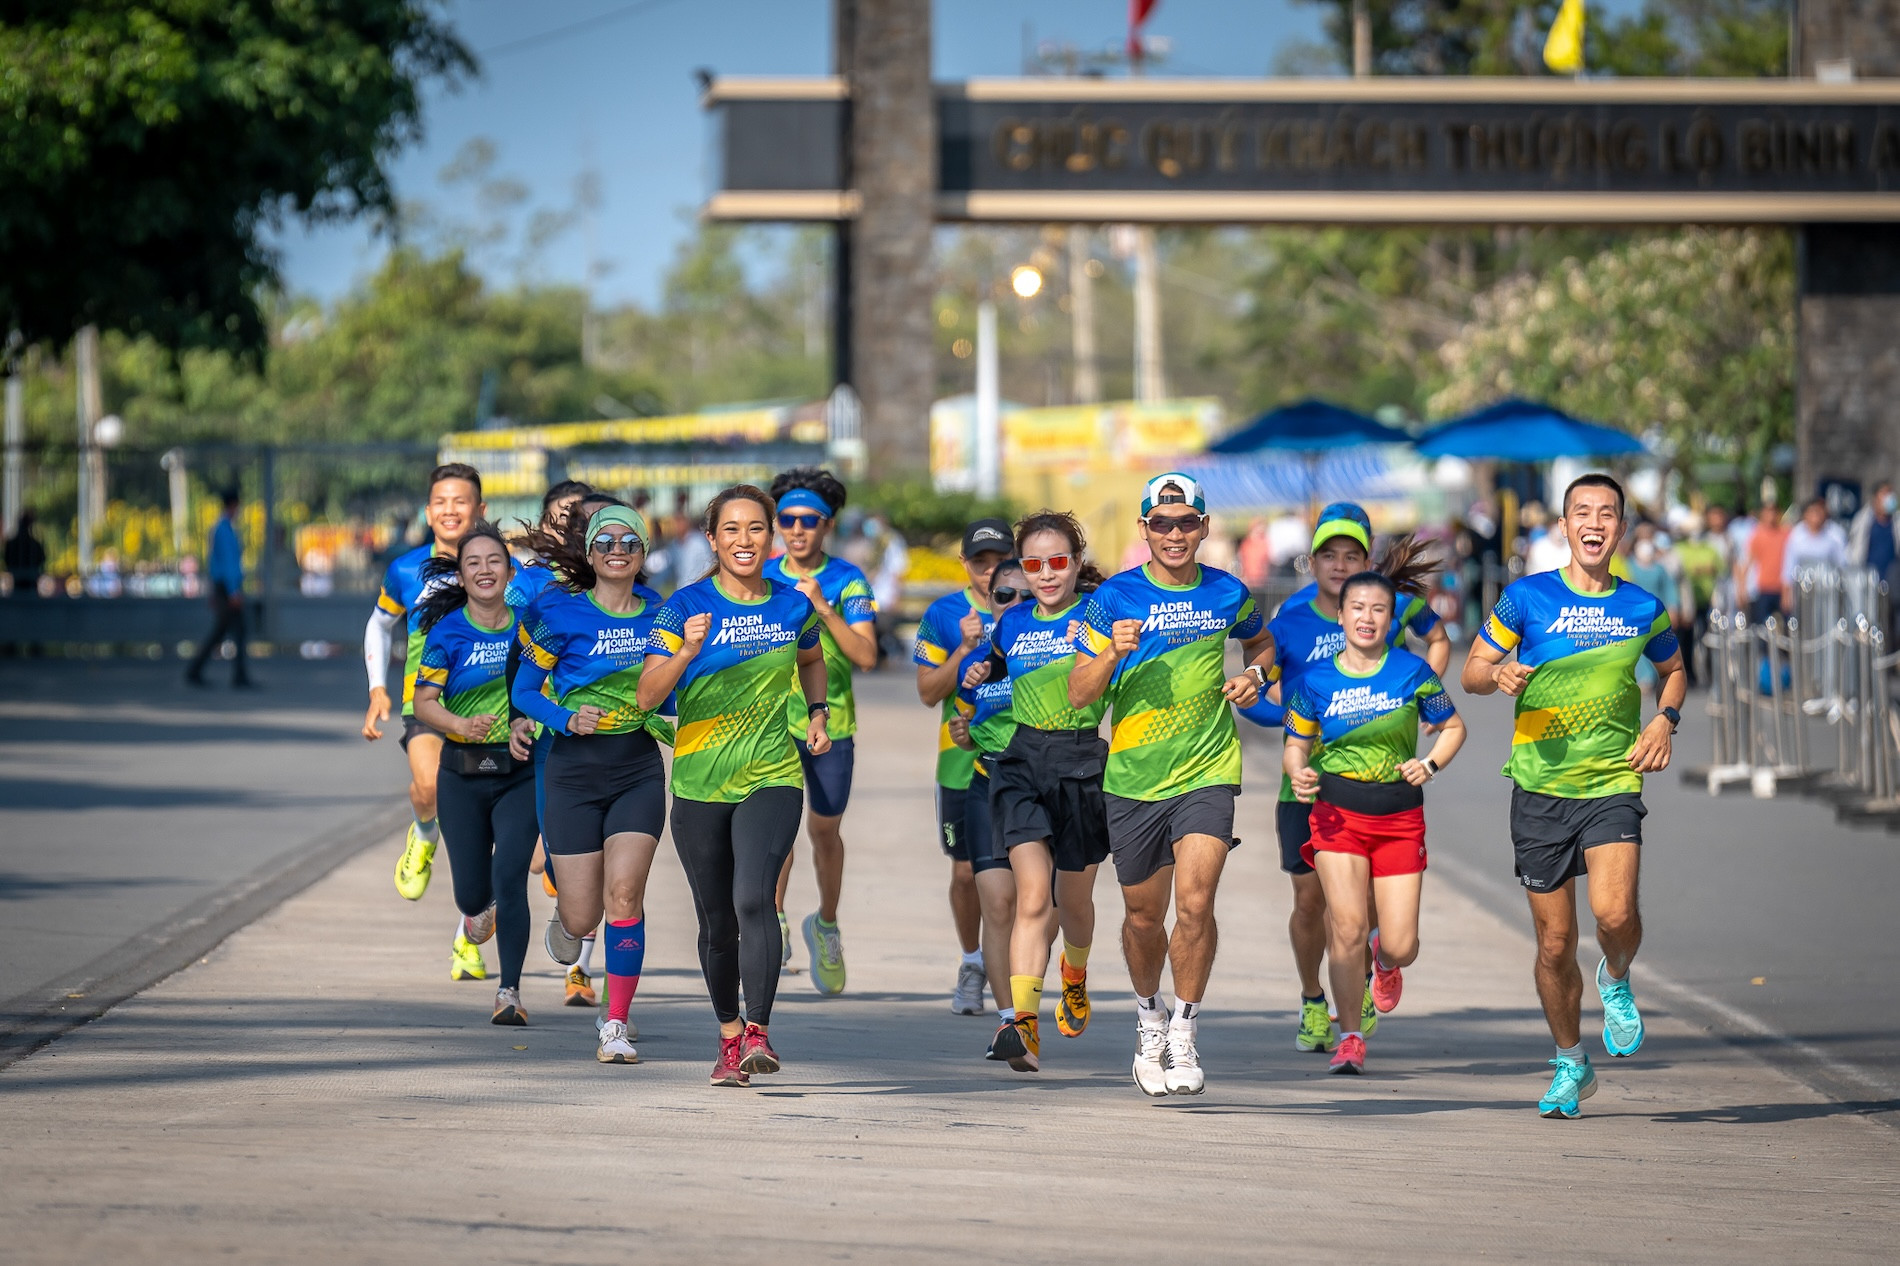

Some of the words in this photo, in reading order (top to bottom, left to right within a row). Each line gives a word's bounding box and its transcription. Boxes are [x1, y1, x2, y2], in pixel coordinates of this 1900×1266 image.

[1150, 601, 1193, 614] BADEN
[1560, 605, 1605, 617] BADEN
[722, 614, 763, 628] BADEN
[1140, 610, 1212, 633] MOUNTAIN
[1545, 617, 1623, 633] MOUNTAIN
[597, 627, 634, 640] BADEN
[711, 623, 782, 645] MOUNTAIN
[1016, 629, 1055, 641] BADEN
[473, 640, 509, 651] BADEN
[1323, 691, 1388, 717] MOUNTAIN
